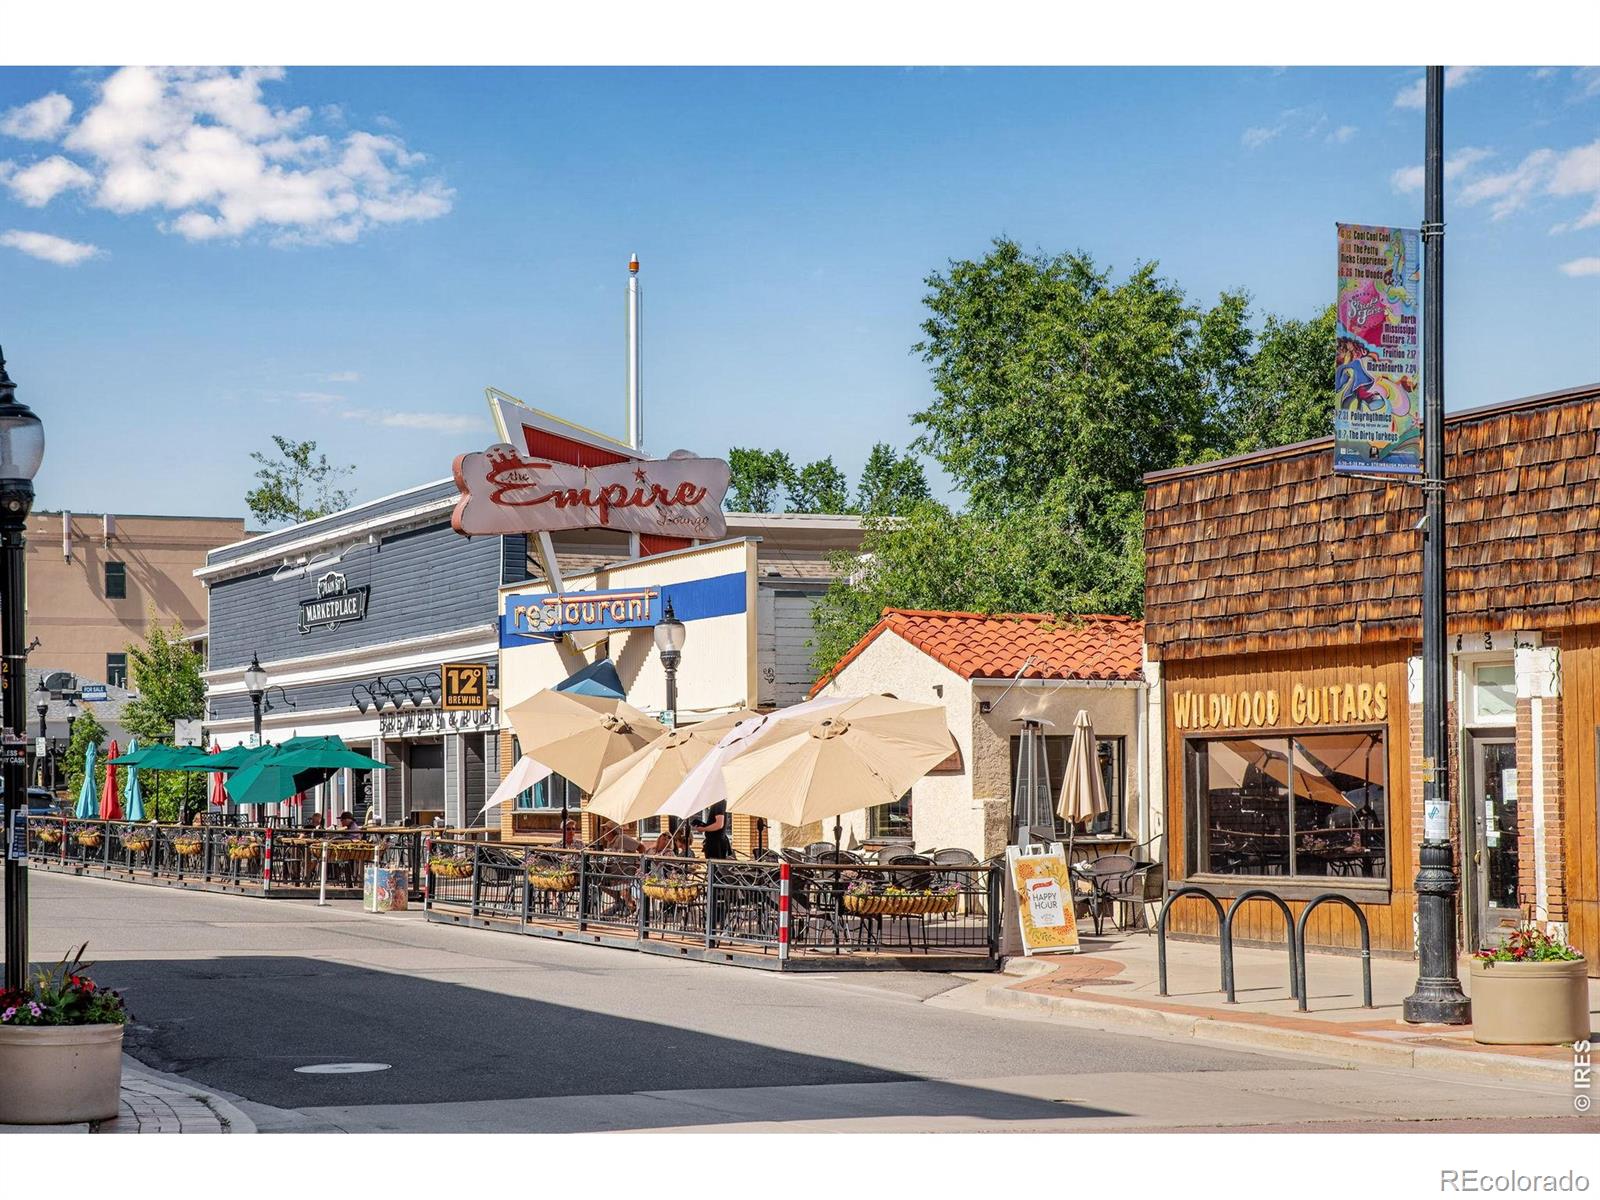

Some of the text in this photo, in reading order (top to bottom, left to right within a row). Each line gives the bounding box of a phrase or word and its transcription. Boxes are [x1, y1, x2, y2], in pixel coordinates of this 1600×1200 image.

[1353, 230, 1366, 240] Cool
[1366, 231, 1378, 241] Cool
[1379, 232, 1391, 242] Cool
[1353, 244, 1363, 254] The
[1363, 245, 1379, 256] Petty
[1356, 255, 1388, 266] Experience
[1354, 268, 1364, 278] The
[1400, 314, 1417, 324] North
[1384, 323, 1417, 335] Mississippi
[1382, 334, 1405, 345] Allstars
[1382, 348, 1406, 359] Fruition
[1350, 411, 1392, 422] Polyrhythmics
[1349, 430, 1359, 440] The
[1360, 430, 1375, 441] Dirty
[1375, 431, 1398, 442] Turkeys
[501, 469, 530, 482] the
[486, 460, 707, 525] Empire
[306, 597, 358, 622] MARKETPLACE
[514, 591, 658, 628] restaurant
[447, 695, 481, 705] BREWING
[1173, 682, 1388, 729] WILDWOOD GUITARS
[379, 708, 493, 733] BREWERY & PUB
[1032, 892, 1057, 902] HAPPY
[1034, 900, 1058, 910] HOUR
